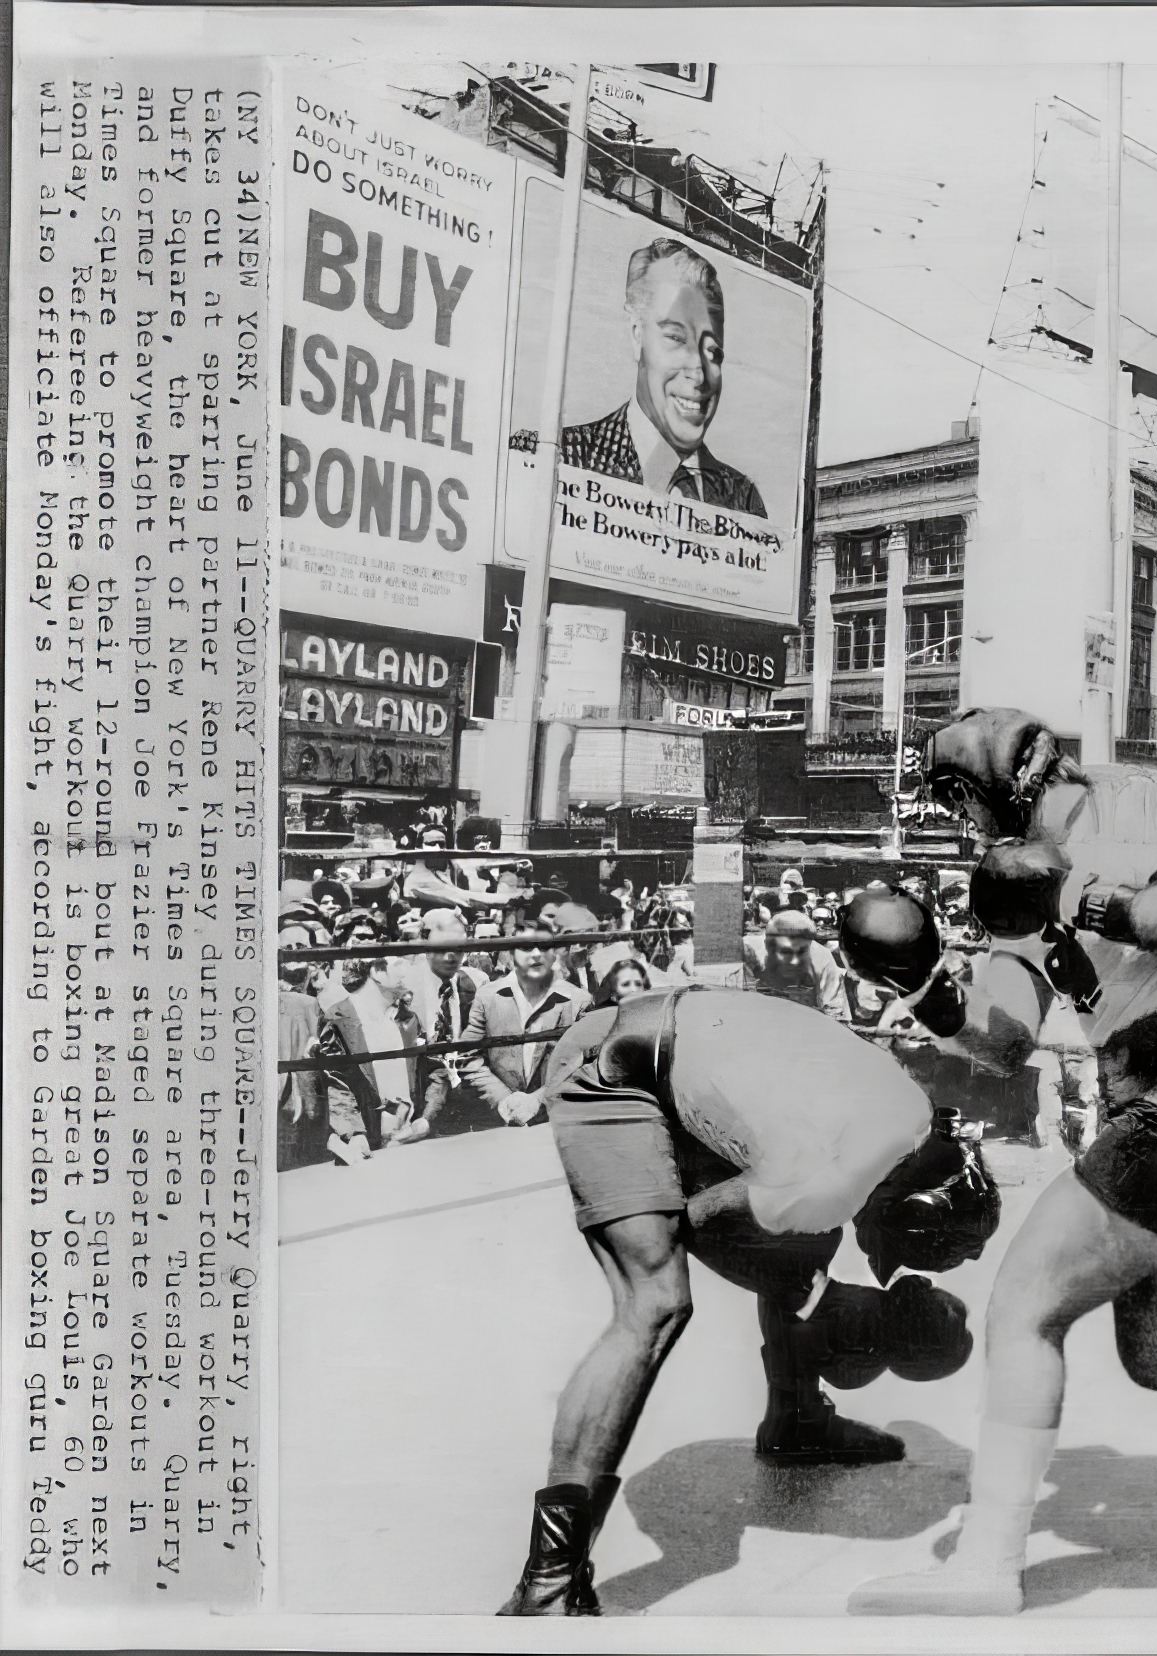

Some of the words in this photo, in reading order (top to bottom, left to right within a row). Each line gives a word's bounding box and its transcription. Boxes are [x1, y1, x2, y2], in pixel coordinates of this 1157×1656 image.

[293, 149, 332, 183] DO
[295, 124, 369, 165] ABOUT
[377, 158, 445, 198] ISRAEL
[296, 95, 359, 134] DON'T
[367, 130, 416, 160] JUST
[424, 153, 493, 192] WORRY
[302, 207, 475, 348] BUY
[280, 323, 474, 456] ISRAEL
[279, 432, 471, 553] BONDS
[593, 510, 673, 555] Bowery
[676, 539, 720, 565] pays
[695, 643, 776, 681] SHOES
